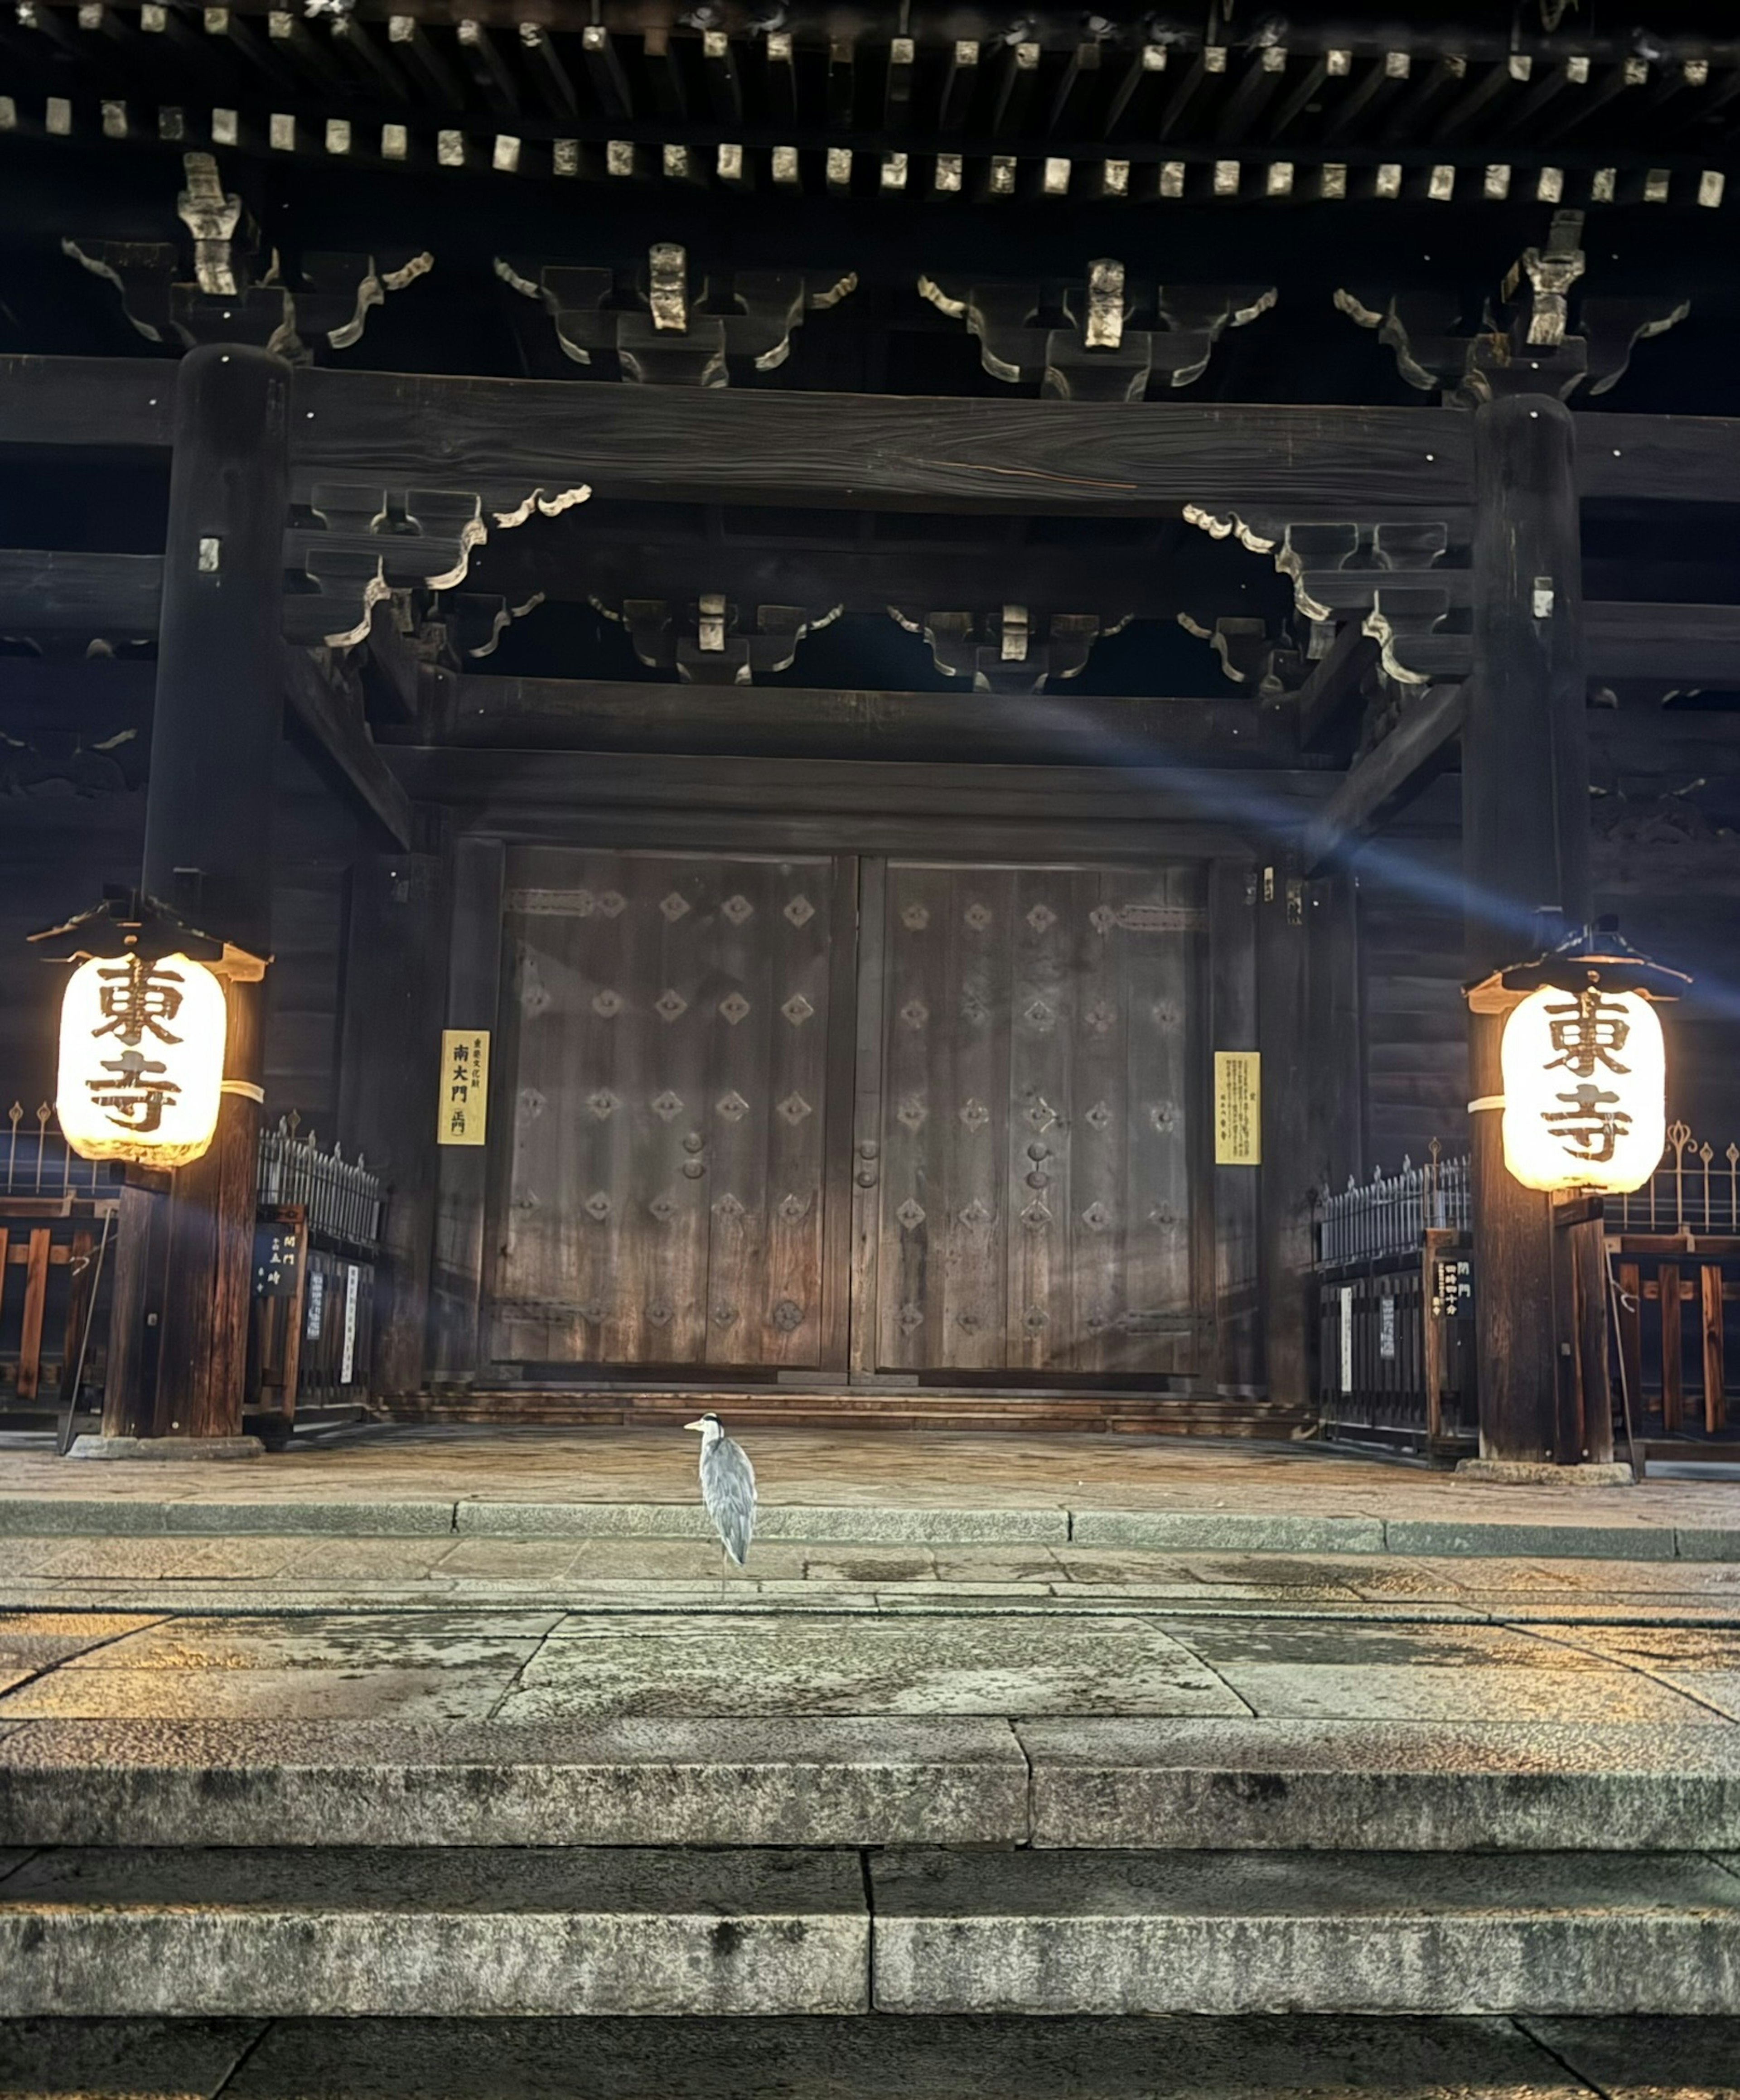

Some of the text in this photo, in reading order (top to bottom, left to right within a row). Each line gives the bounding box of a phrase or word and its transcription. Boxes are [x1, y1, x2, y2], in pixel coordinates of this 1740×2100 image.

[86, 957, 185, 1132] 東寺
[451, 1044, 469, 1103] 南大門
[1540, 990, 1633, 1162] 東寺
